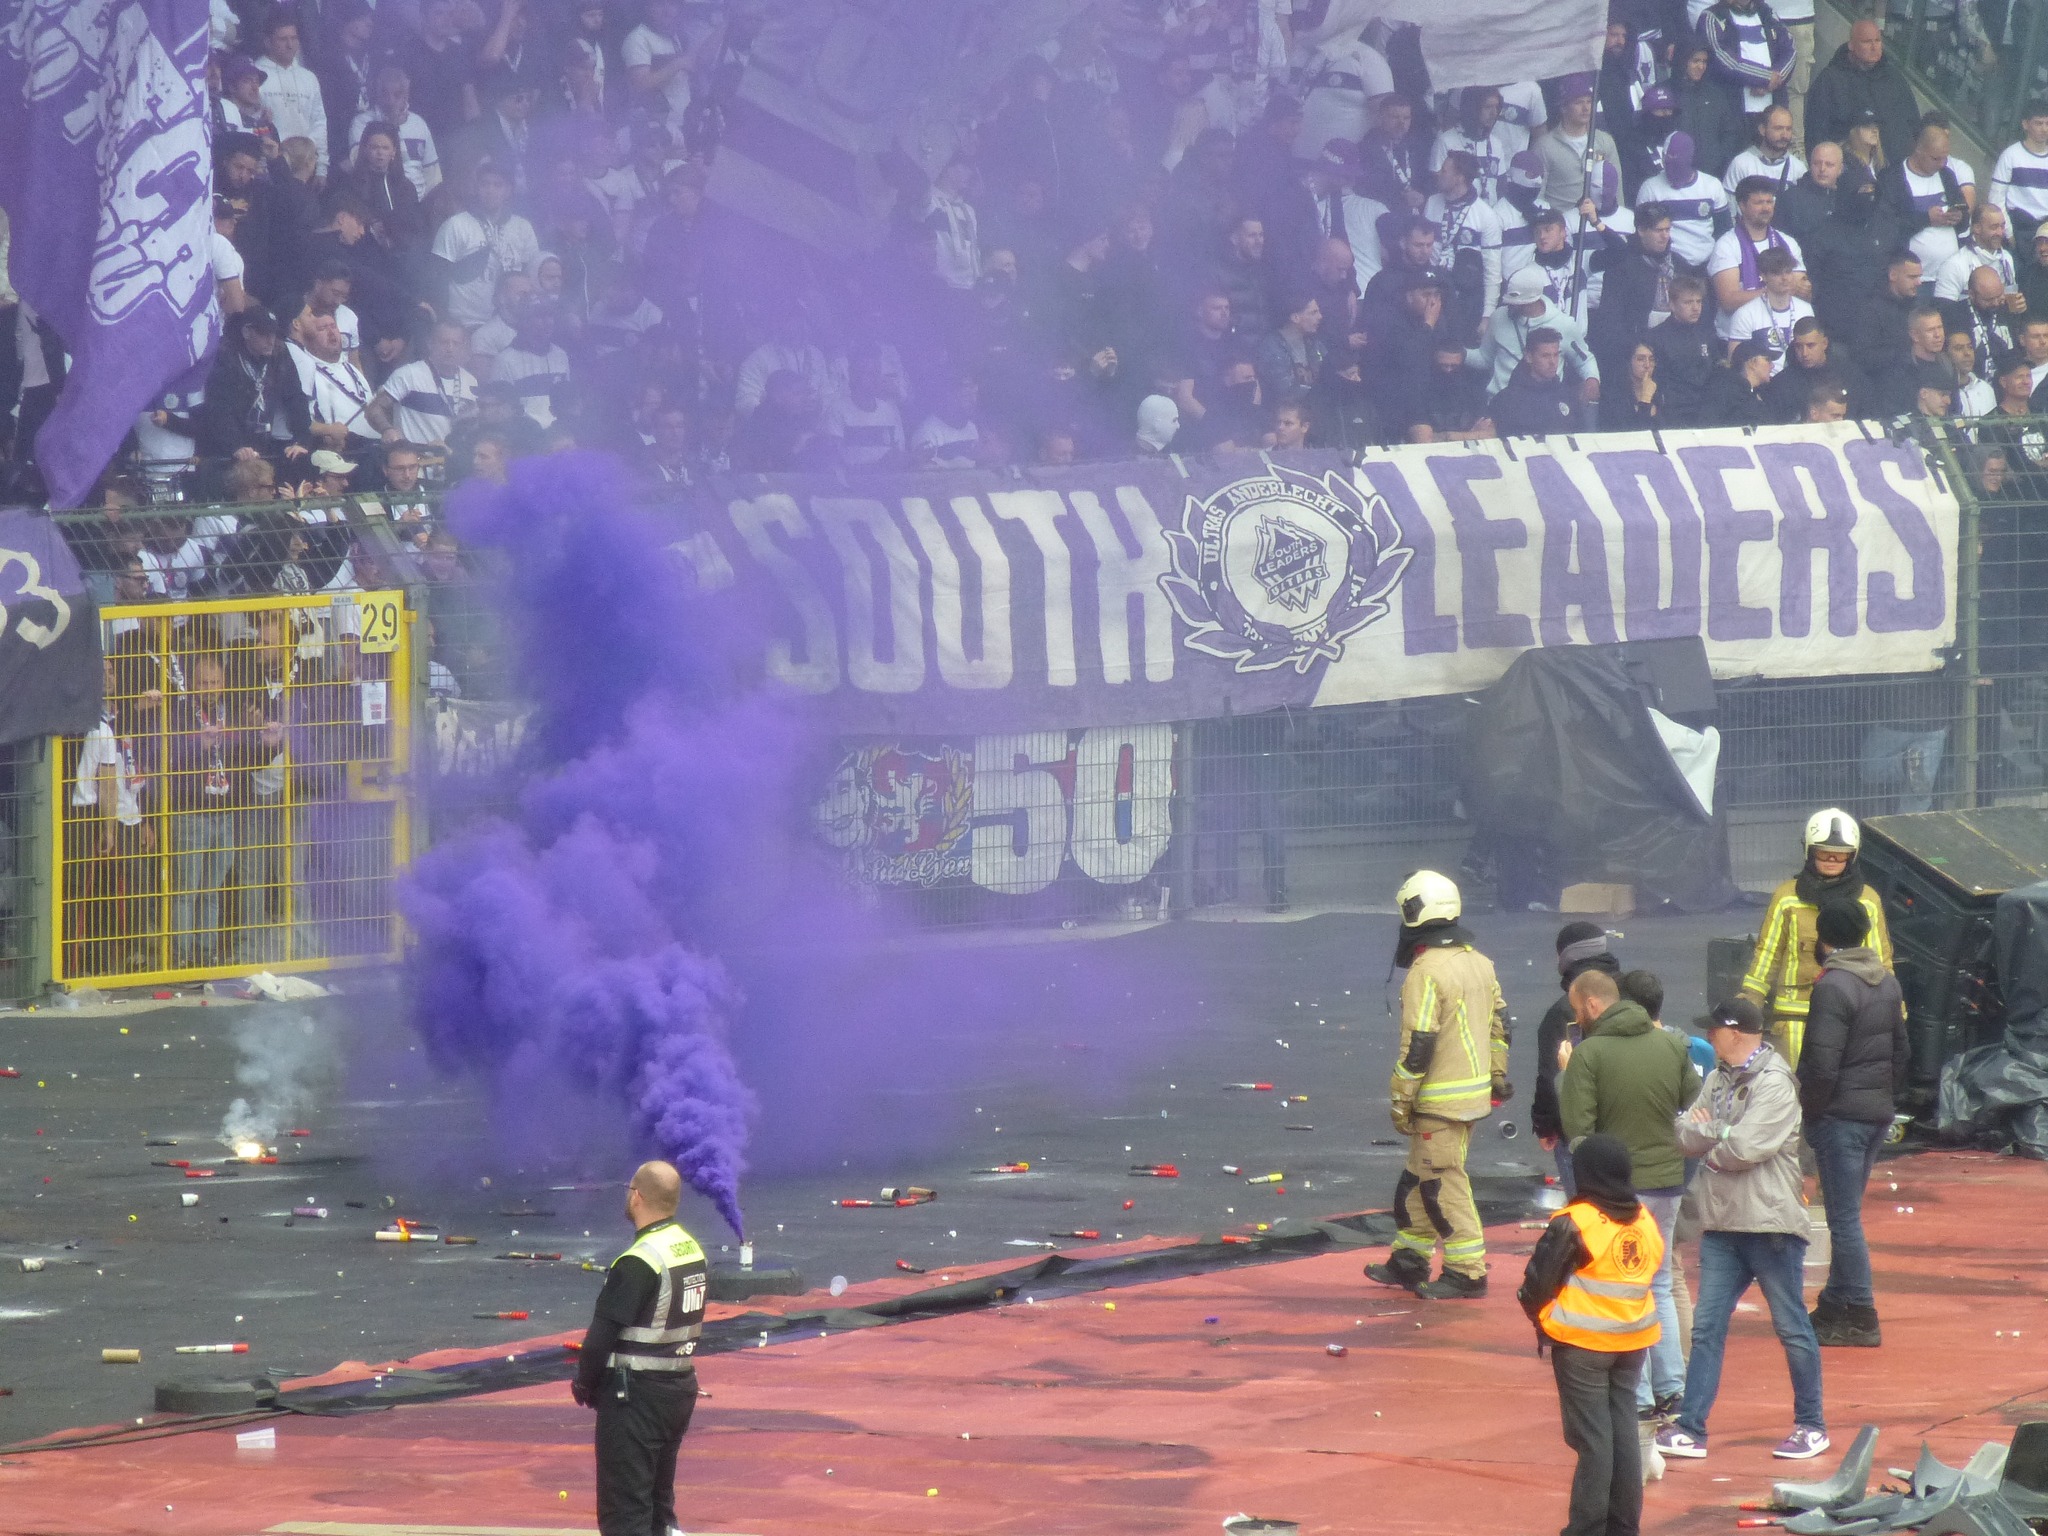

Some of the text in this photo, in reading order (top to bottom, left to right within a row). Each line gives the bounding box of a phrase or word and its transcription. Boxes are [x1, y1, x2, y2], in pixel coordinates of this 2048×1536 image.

[1203, 480, 1346, 564] ULTRAS ANDERLECHT
[1268, 538, 1303, 560] SOUTH
[728, 438, 1946, 694] SOUTH LEADERS
[1259, 541, 1318, 576] LEADERS
[1271, 567, 1323, 596] ULTRAS
[0, 549, 71, 650] 3
[362, 603, 397, 643] 29
[972, 726, 1172, 895] 50
